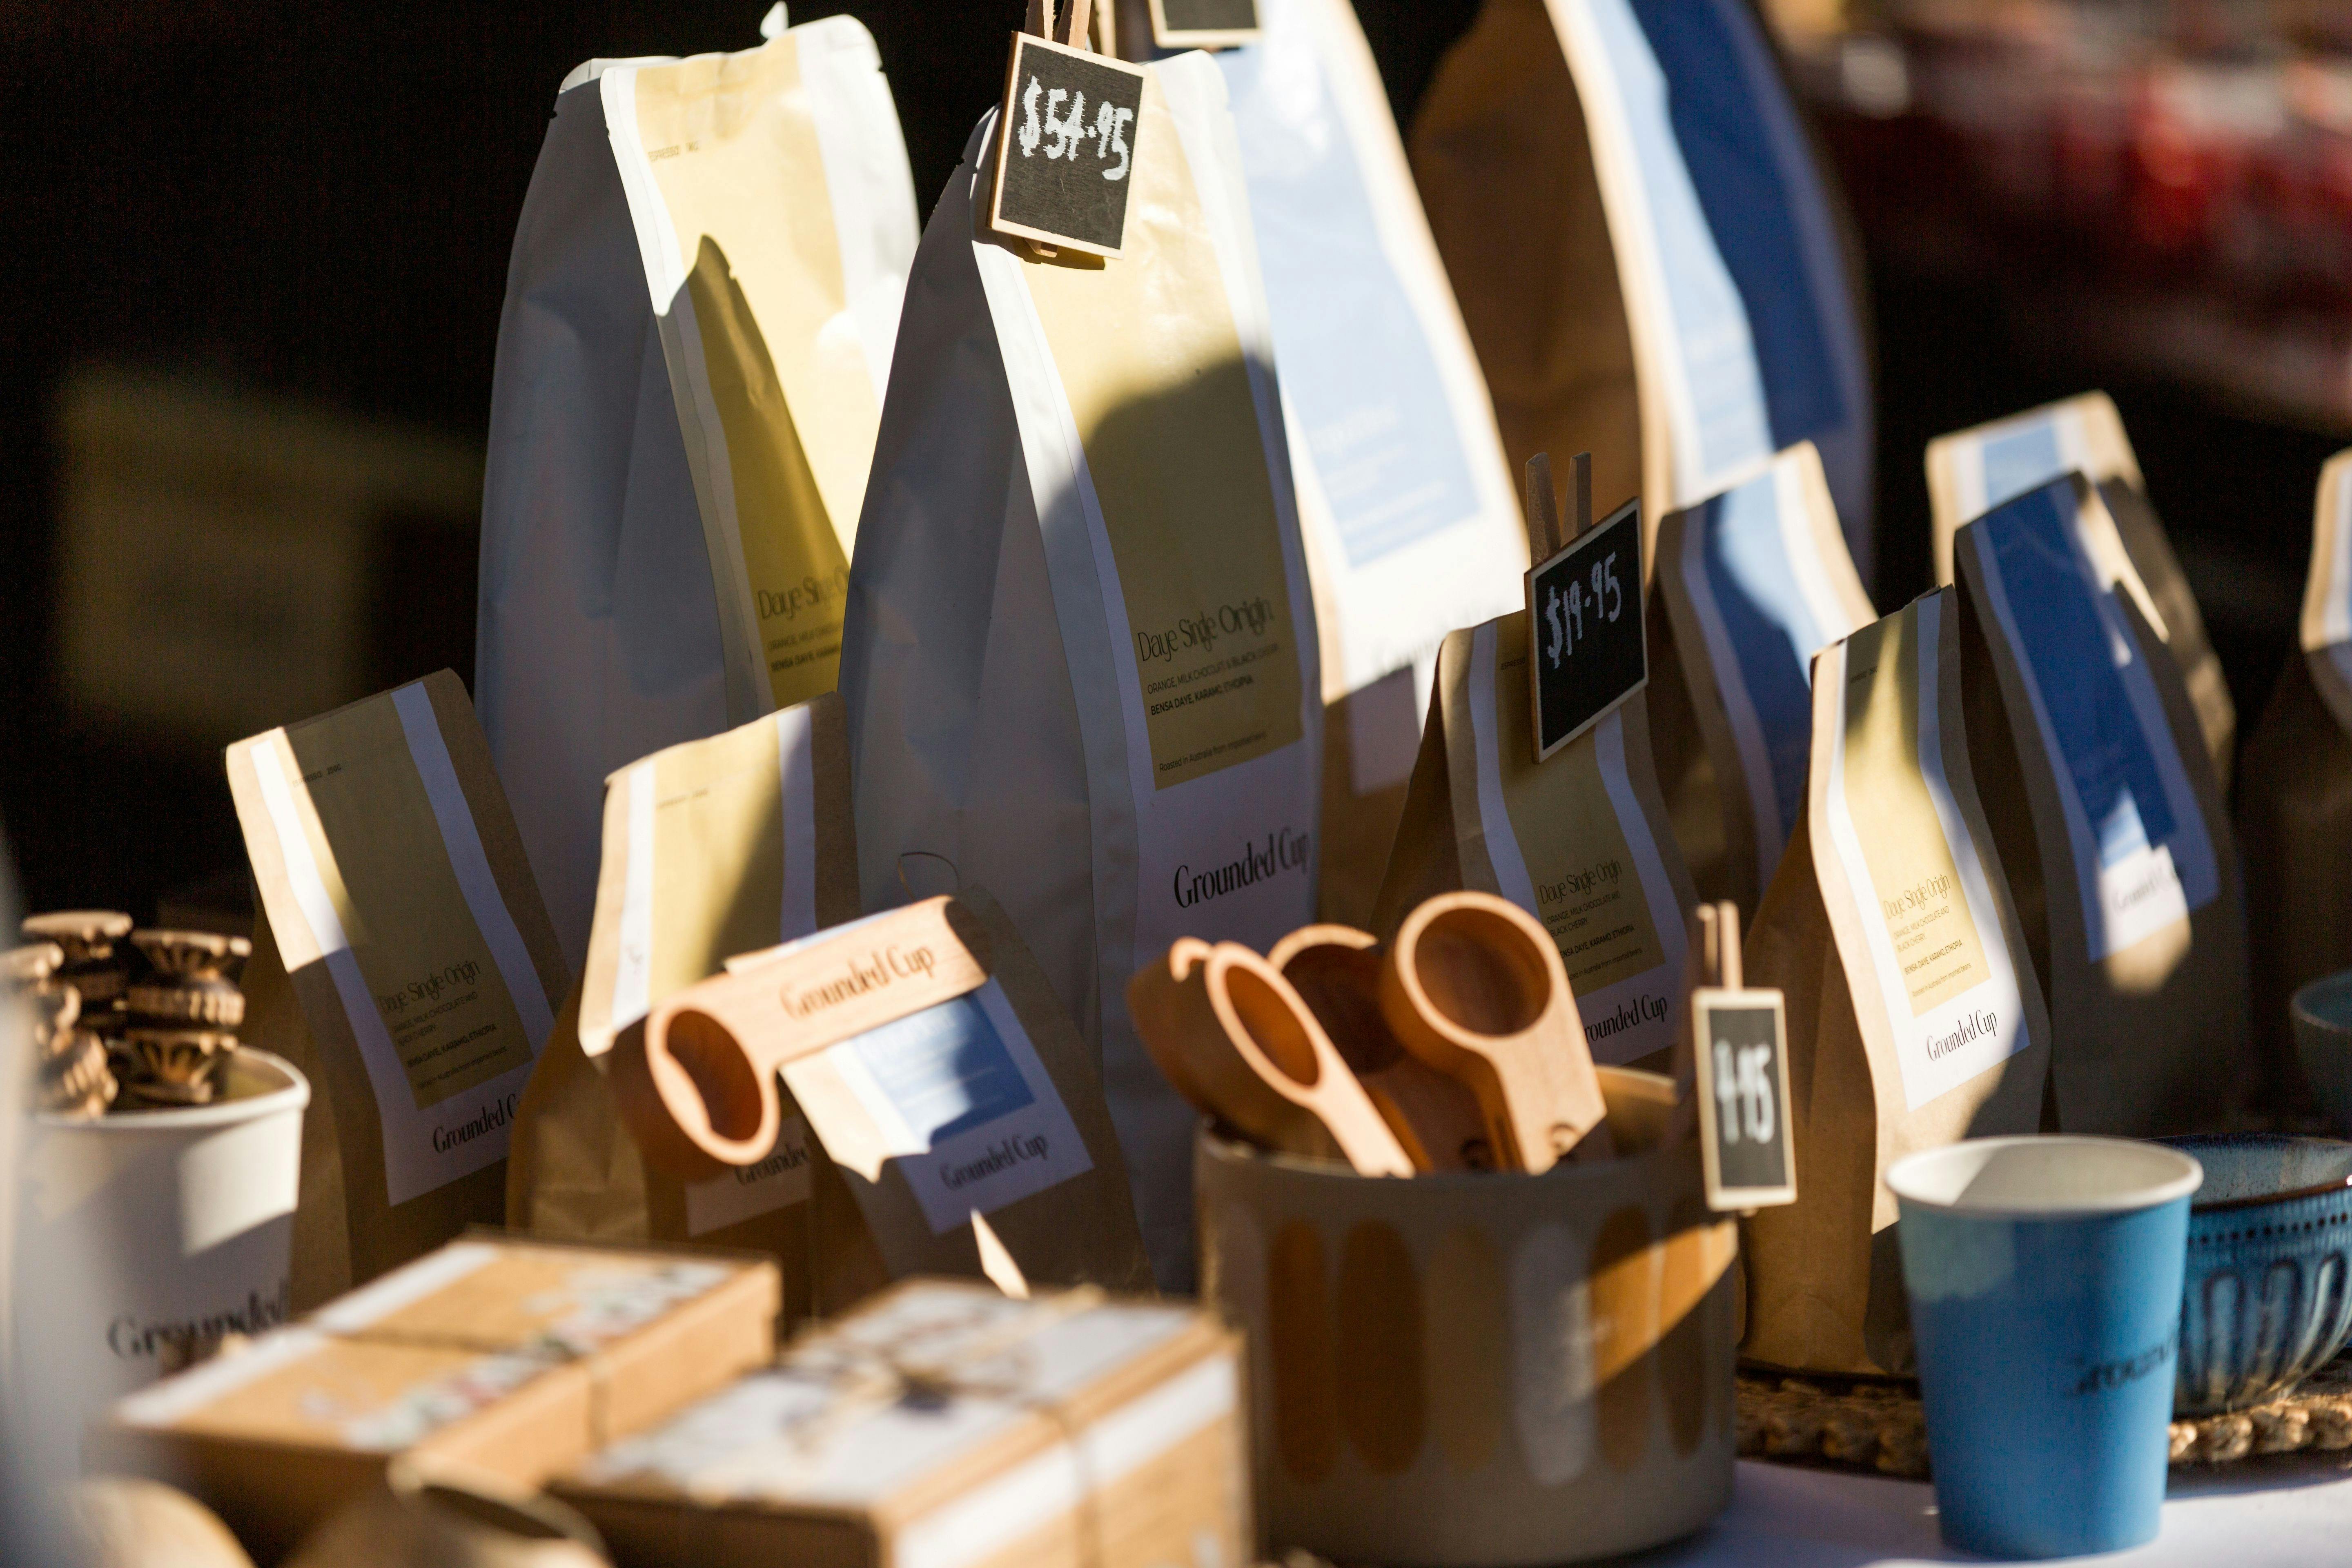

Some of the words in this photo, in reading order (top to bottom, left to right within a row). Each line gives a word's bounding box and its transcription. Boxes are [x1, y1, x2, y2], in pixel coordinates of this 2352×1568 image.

[1138, 630, 1178, 662] Daye
[1179, 611, 1217, 651] Single
[1218, 597, 1275, 636] Origin
[1147, 677, 1177, 694] ORANGE,
[1150, 700, 1174, 716] BENSA
[1174, 693, 1194, 708] DAYE,
[1160, 757, 1182, 772] Roasted
[1183, 756, 1188, 765] in
[1174, 833, 1276, 908] Grounded
[1278, 826, 1309, 875] Cup
[1539, 882, 1567, 904] Daye
[1566, 868, 1596, 895] Single
[1596, 859, 1622, 884] Origin
[1883, 898, 1906, 920] Daye
[1904, 883, 1928, 910] Single
[1927, 874, 1951, 899] Origin
[886, 946, 936, 979] Cup
[1560, 947, 1575, 959] ENSA
[1904, 963, 1918, 975] BENSA
[407, 973, 445, 1000] Single
[444, 960, 481, 985] Origin
[1584, 998, 1640, 1044] rounded
[1642, 994, 1668, 1022] Cup
[1927, 1014, 1976, 1062] Grounded
[1976, 1009, 1998, 1037] Cup
[433, 1098, 506, 1154] Grounded
